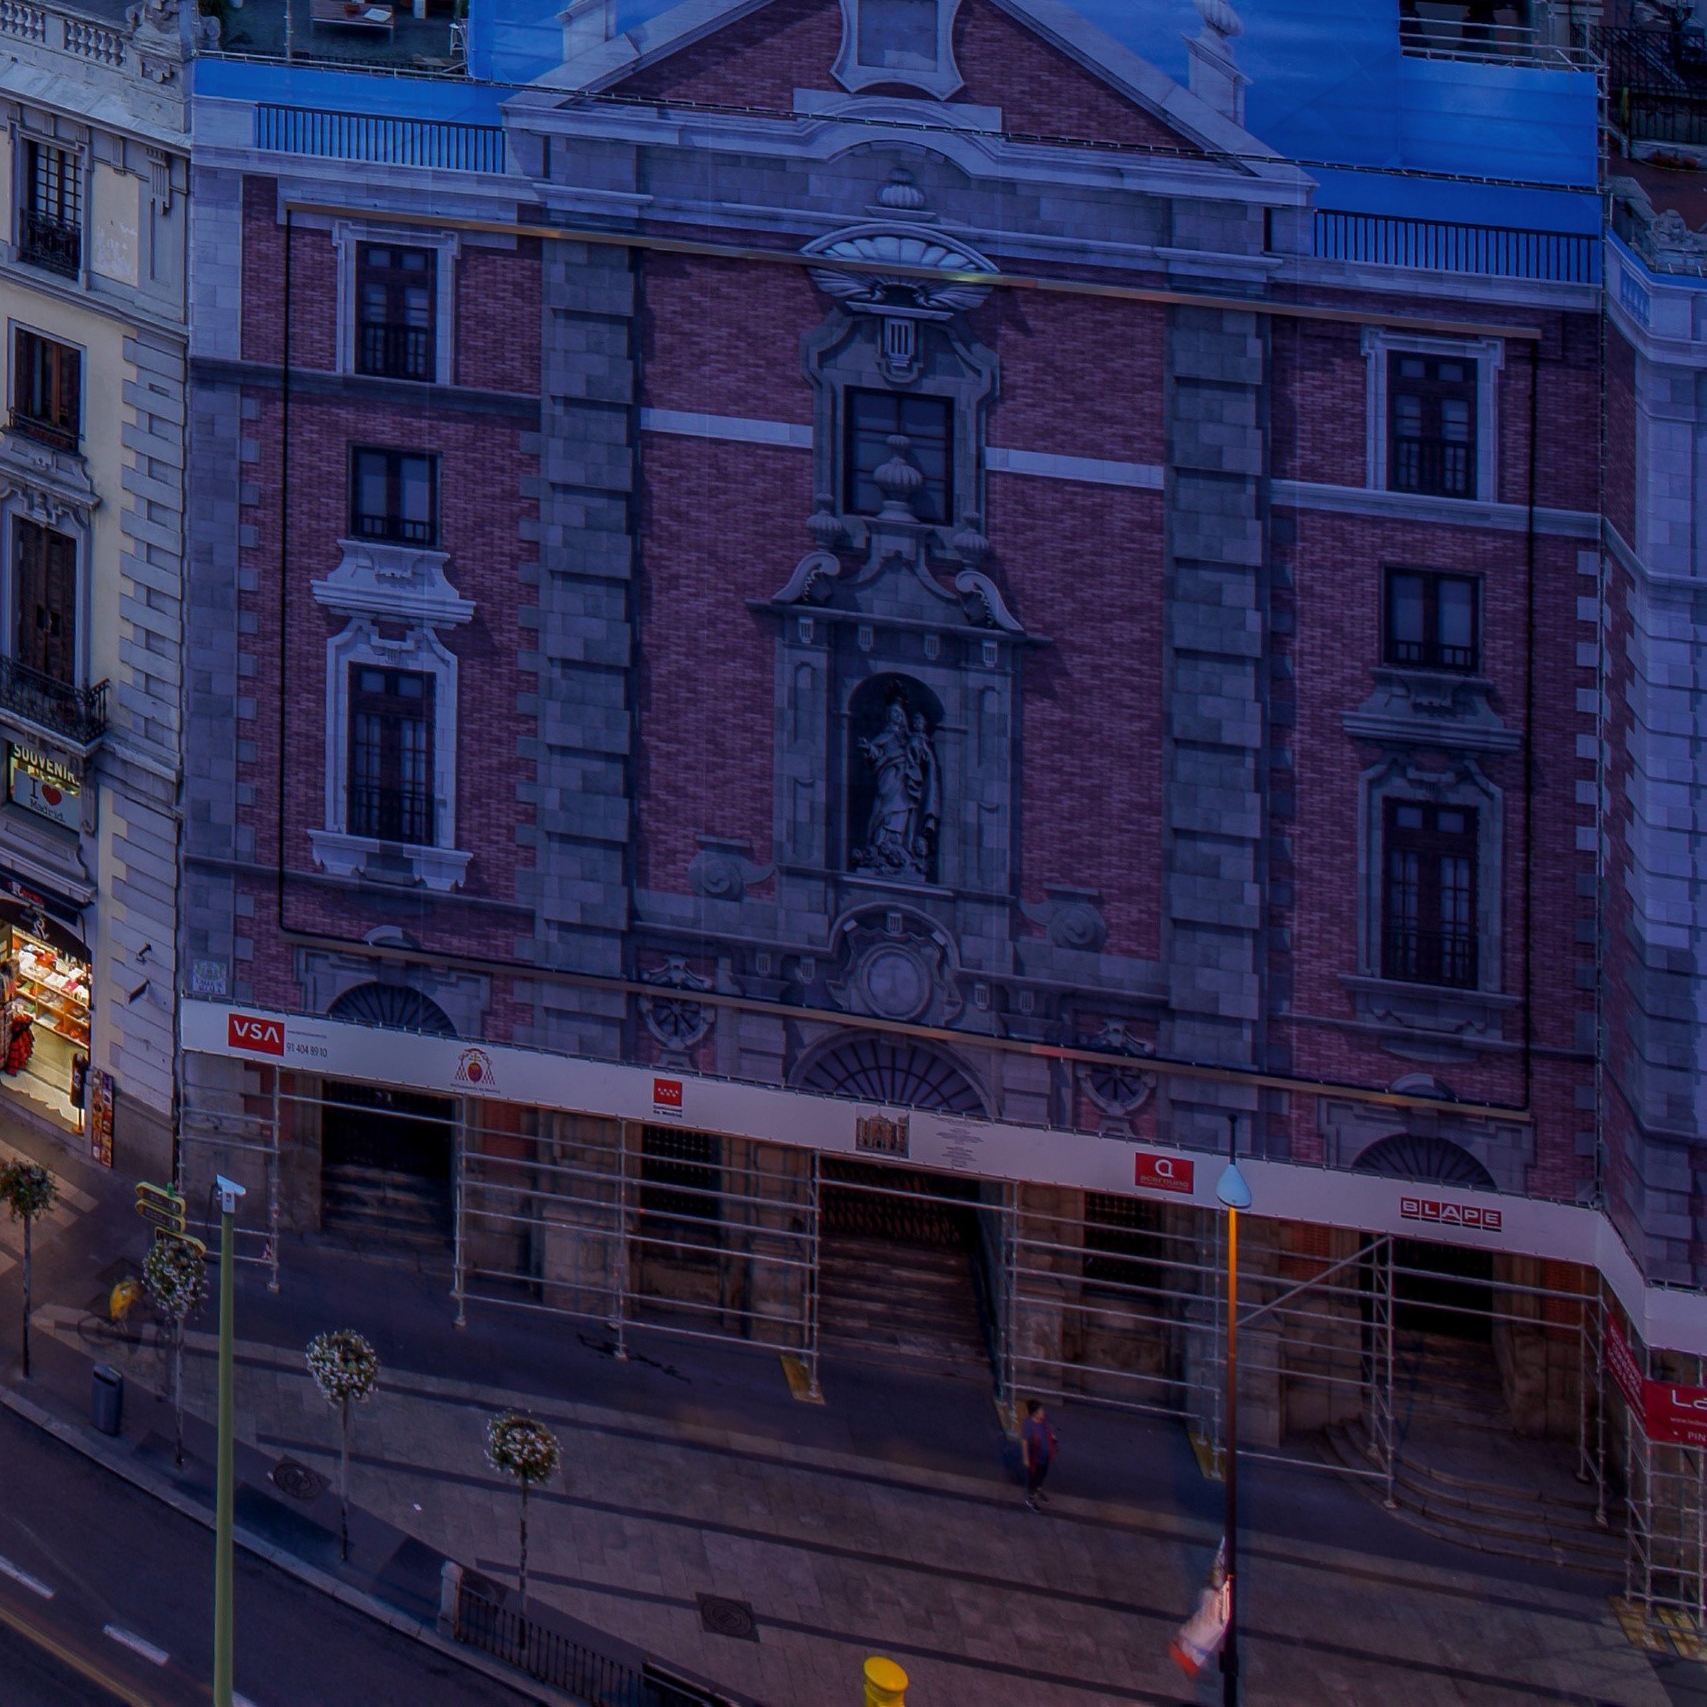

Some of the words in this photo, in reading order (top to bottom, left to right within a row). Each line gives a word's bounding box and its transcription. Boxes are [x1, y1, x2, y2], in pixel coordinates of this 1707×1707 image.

[29, 777, 38, 800] I
[233, 1019, 280, 1044] VSA
[1402, 1200, 1499, 1225] BLAPE
